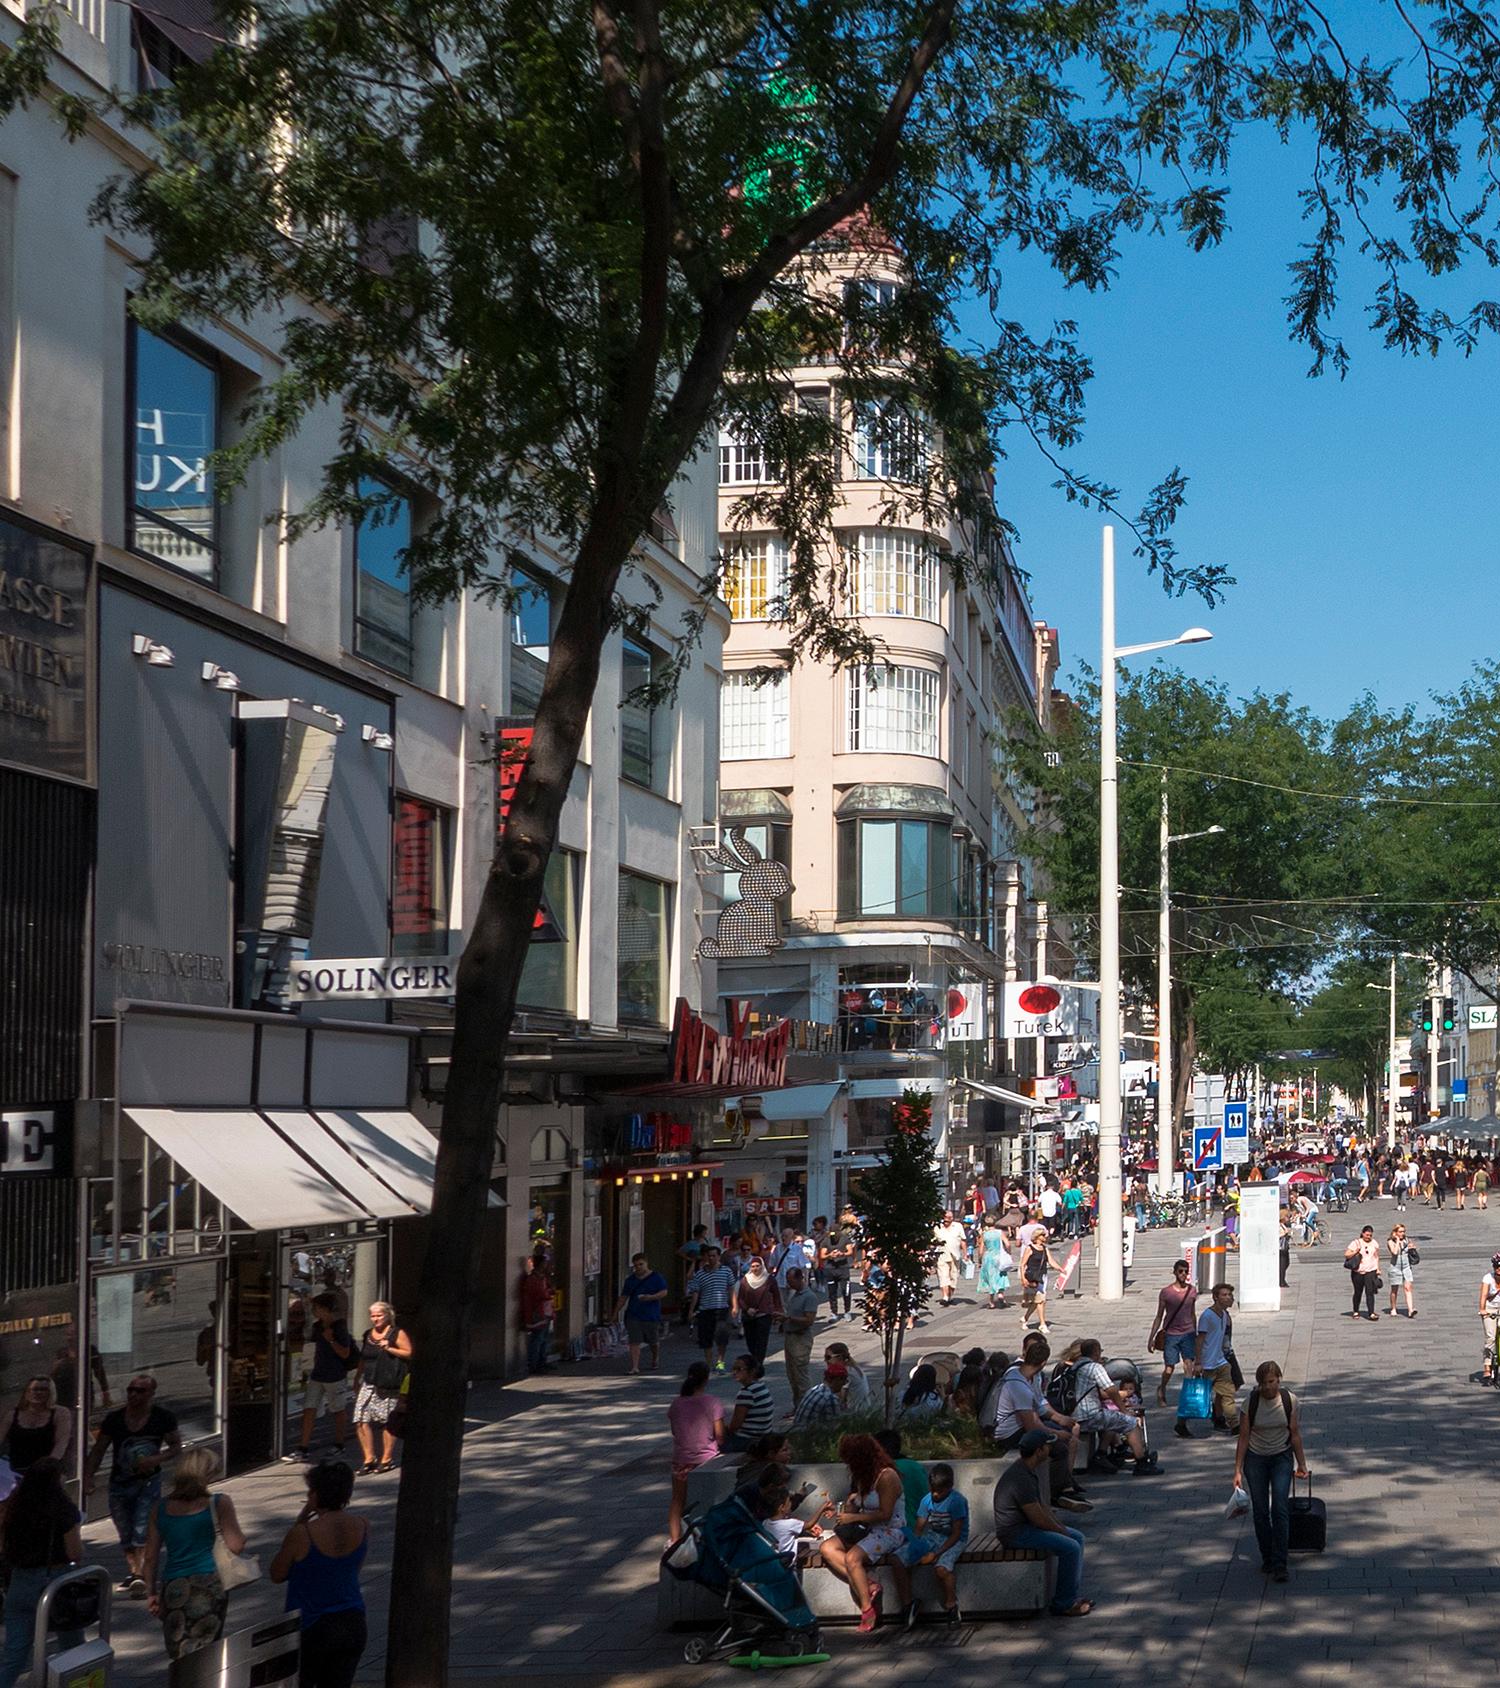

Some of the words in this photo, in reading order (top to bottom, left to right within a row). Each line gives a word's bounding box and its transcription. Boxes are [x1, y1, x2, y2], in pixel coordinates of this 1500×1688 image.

[296, 964, 453, 994] SOLINGER
[1014, 1018, 1065, 1035] Turek
[746, 1199, 798, 1214] SALE
